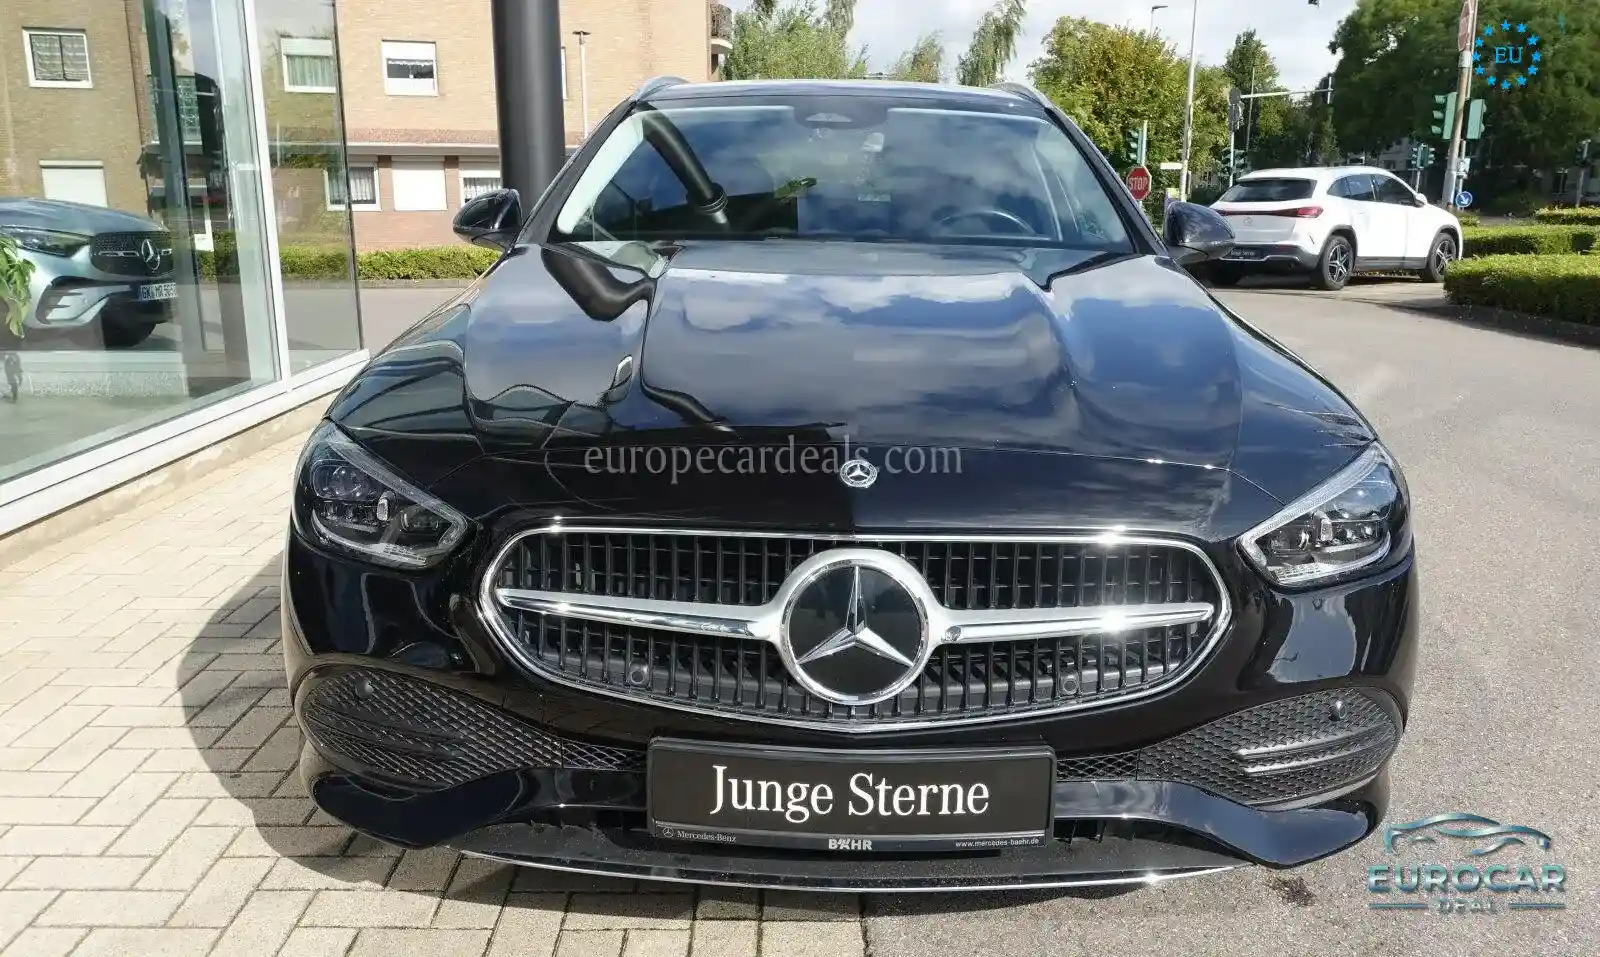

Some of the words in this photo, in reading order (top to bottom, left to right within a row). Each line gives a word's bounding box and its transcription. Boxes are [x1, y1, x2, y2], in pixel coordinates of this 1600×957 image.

[1128, 176, 1148, 190] STOP
[710, 764, 834, 824] Junge
[848, 772, 990, 817] Sterne
[677, 830, 737, 843] Mercedes-Benz
